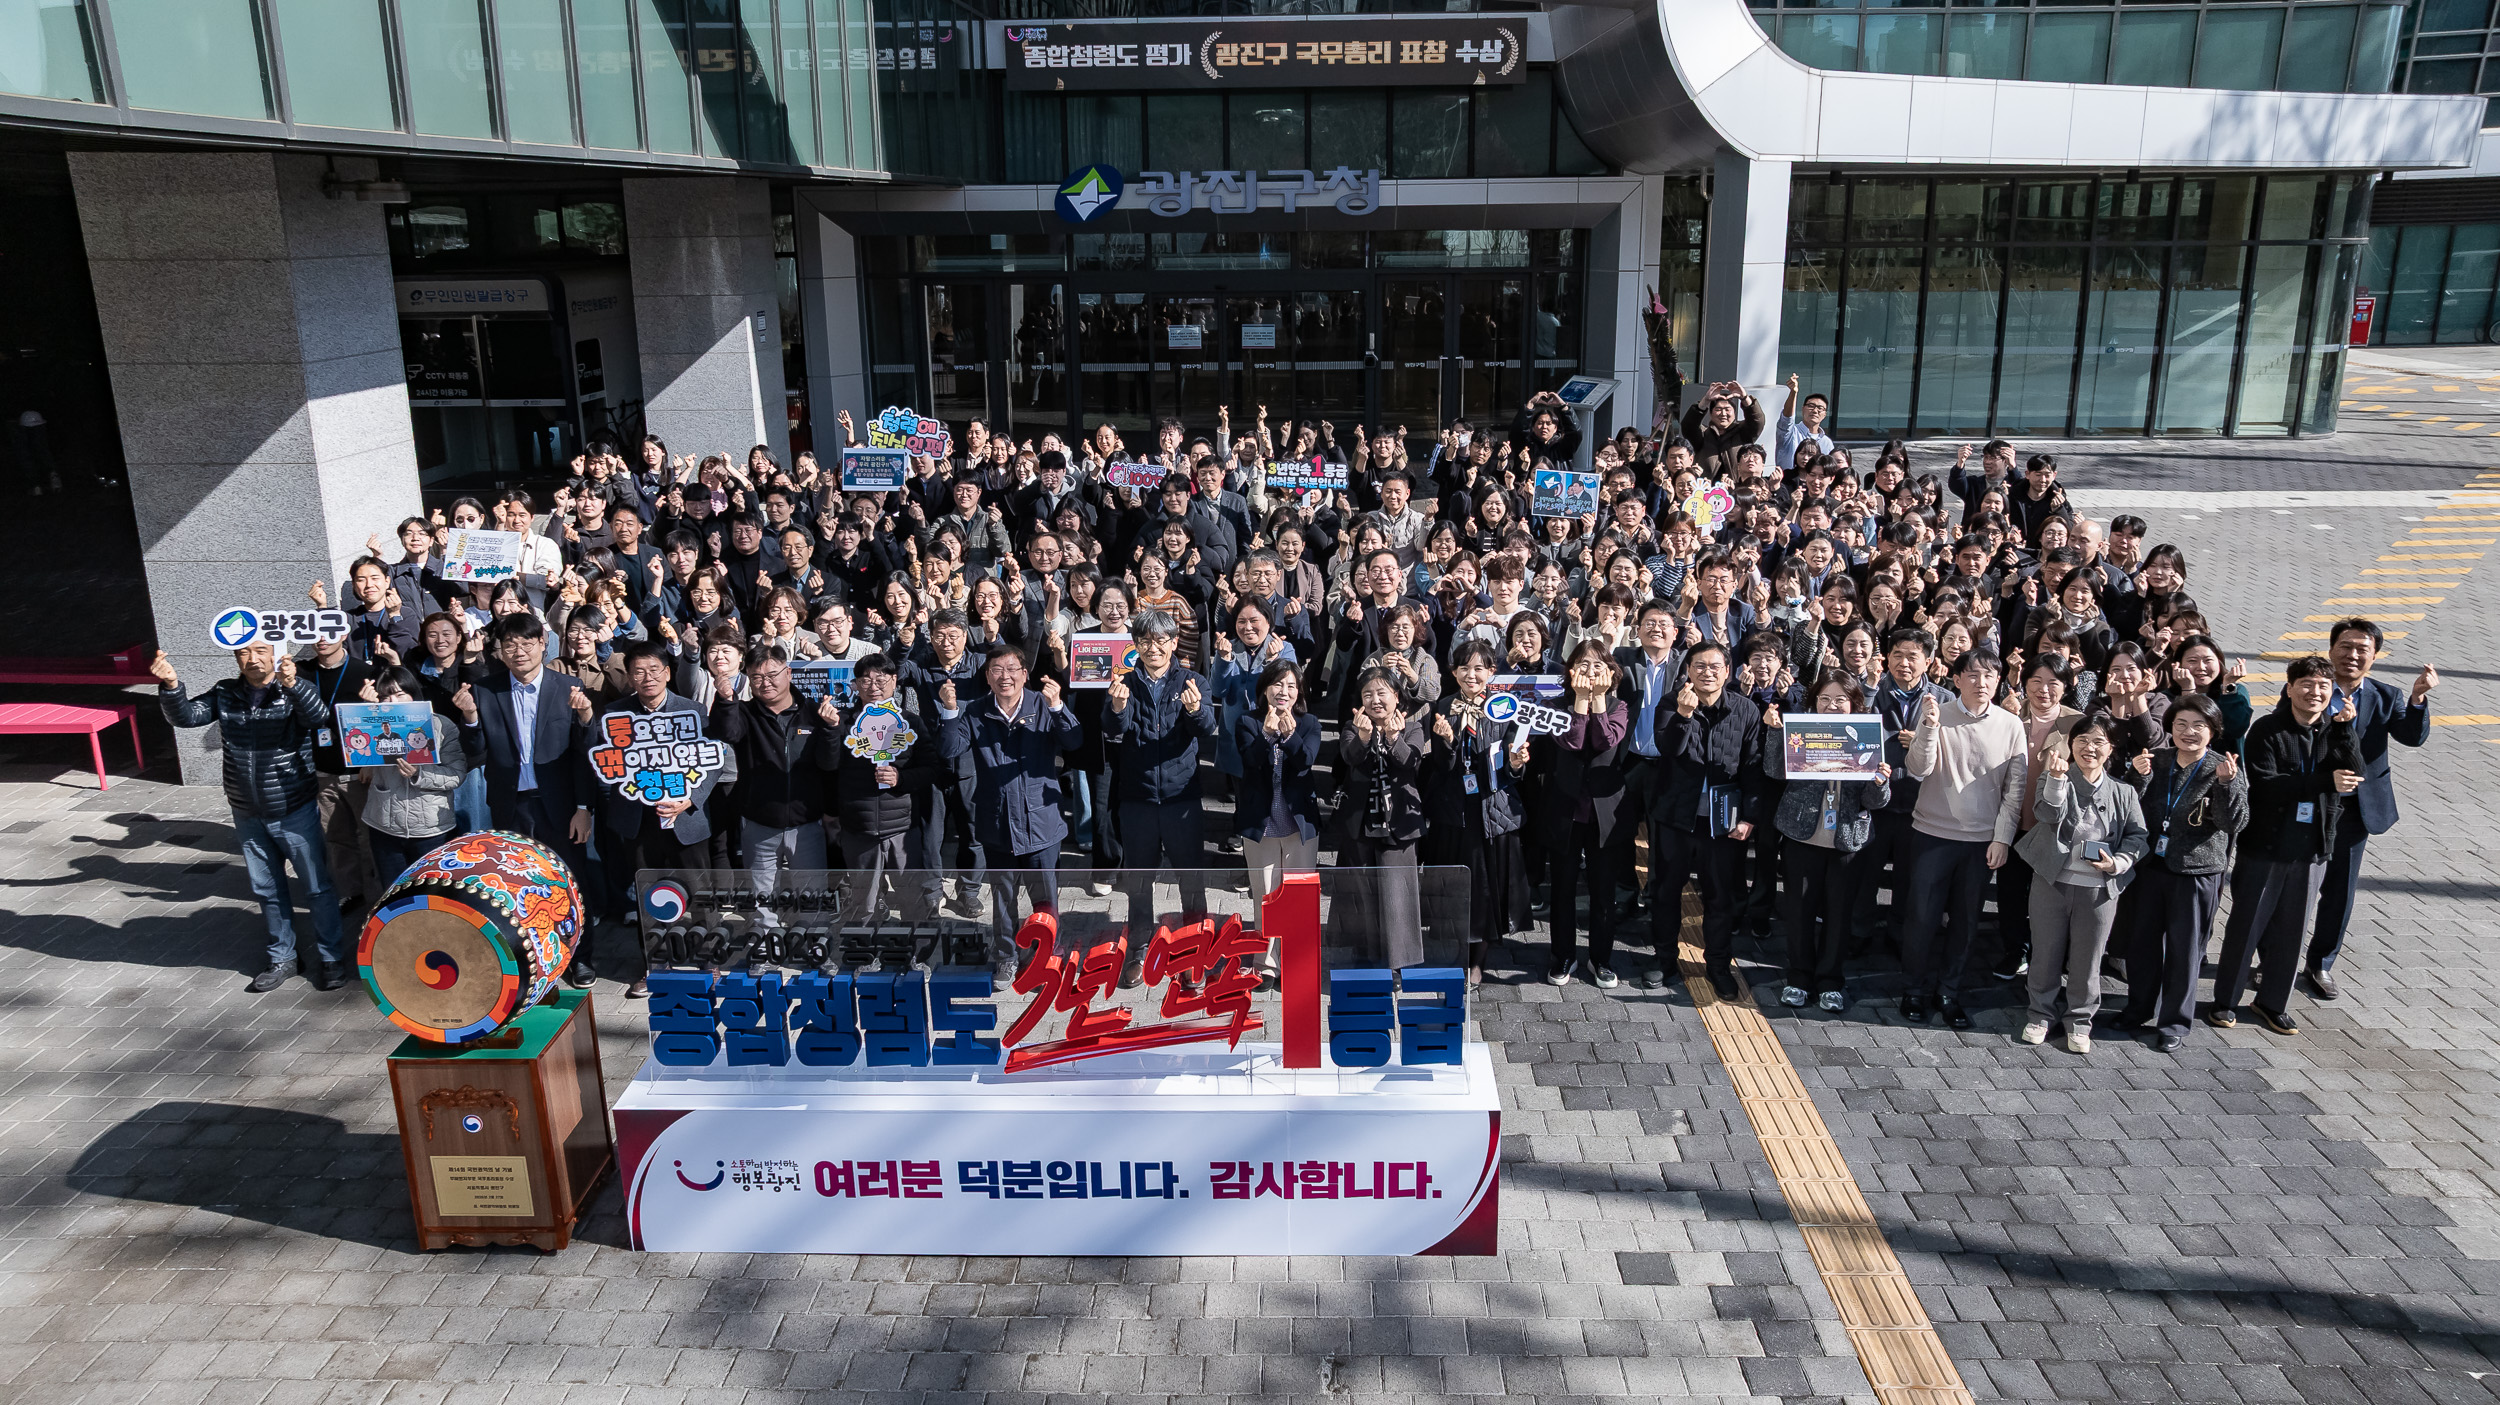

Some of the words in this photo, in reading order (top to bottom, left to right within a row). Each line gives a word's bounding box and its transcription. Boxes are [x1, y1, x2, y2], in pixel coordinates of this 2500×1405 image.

[1024, 43, 1139, 68] 종합청렴도
[1145, 43, 1192, 67] 평가
[1215, 42, 1288, 67] 광진구
[1296, 40, 1392, 65] 국무총리
[1399, 39, 1448, 64] 표창
[1455, 39, 1504, 63] 수상
[1135, 165, 1381, 218] 광진구청
[424, 289, 529, 304] 무인민원발급창구
[425, 372, 446, 380] CCTV
[416, 389, 439, 397] 24시간
[1266, 476, 1297, 488] 여러분
[1298, 477, 1348, 489] 덕분입니다
[261, 613, 346, 642] 광진구
[1518, 704, 1568, 734] 광진구
[674, 743, 719, 767] 않는
[635, 770, 685, 801] 청렴
[646, 925, 831, 966] 2023-2025
[838, 924, 989, 966] 공공기관
[646, 970, 1002, 1068] 종합청렴도
[1143, 912, 1270, 1053] 연속
[731, 1159, 763, 1173] 소통하며
[764, 1159, 800, 1173] 발전하는
[814, 1159, 944, 1199] 여러분
[957, 1159, 1190, 1200] 덕분입니다.
[1209, 1159, 1443, 1201] 감사합니다.
[731, 1170, 802, 1193] 행복광진
